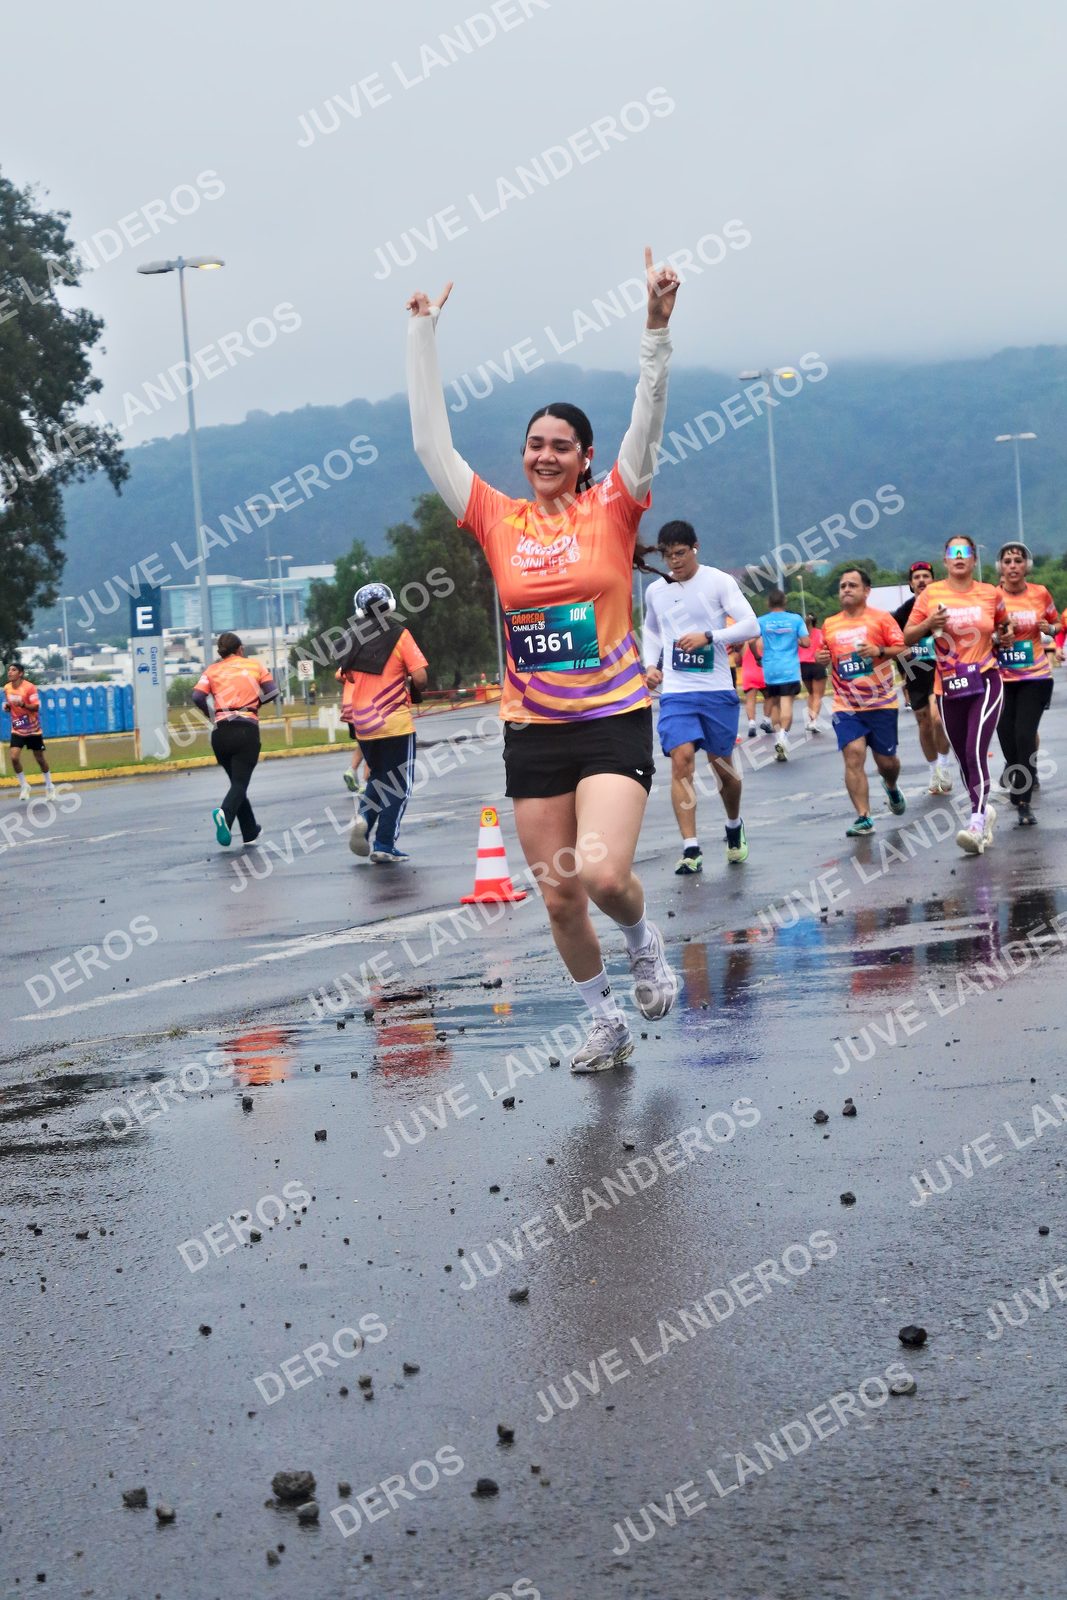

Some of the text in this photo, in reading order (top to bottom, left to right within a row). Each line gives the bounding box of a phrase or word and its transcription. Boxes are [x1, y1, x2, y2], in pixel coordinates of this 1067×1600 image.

[136, 606, 154, 630] E
[511, 611, 545, 625] CARRERA
[569, 607, 587, 621] 10K
[512, 623, 538, 633] OMNILIFE
[524, 631, 573, 653] 1361
[678, 652, 704, 664] 1216
[1002, 651, 1026, 661] 1156
[150, 646, 160, 686] General
[842, 661, 866, 673] 1331
[948, 678, 969, 690] 458
